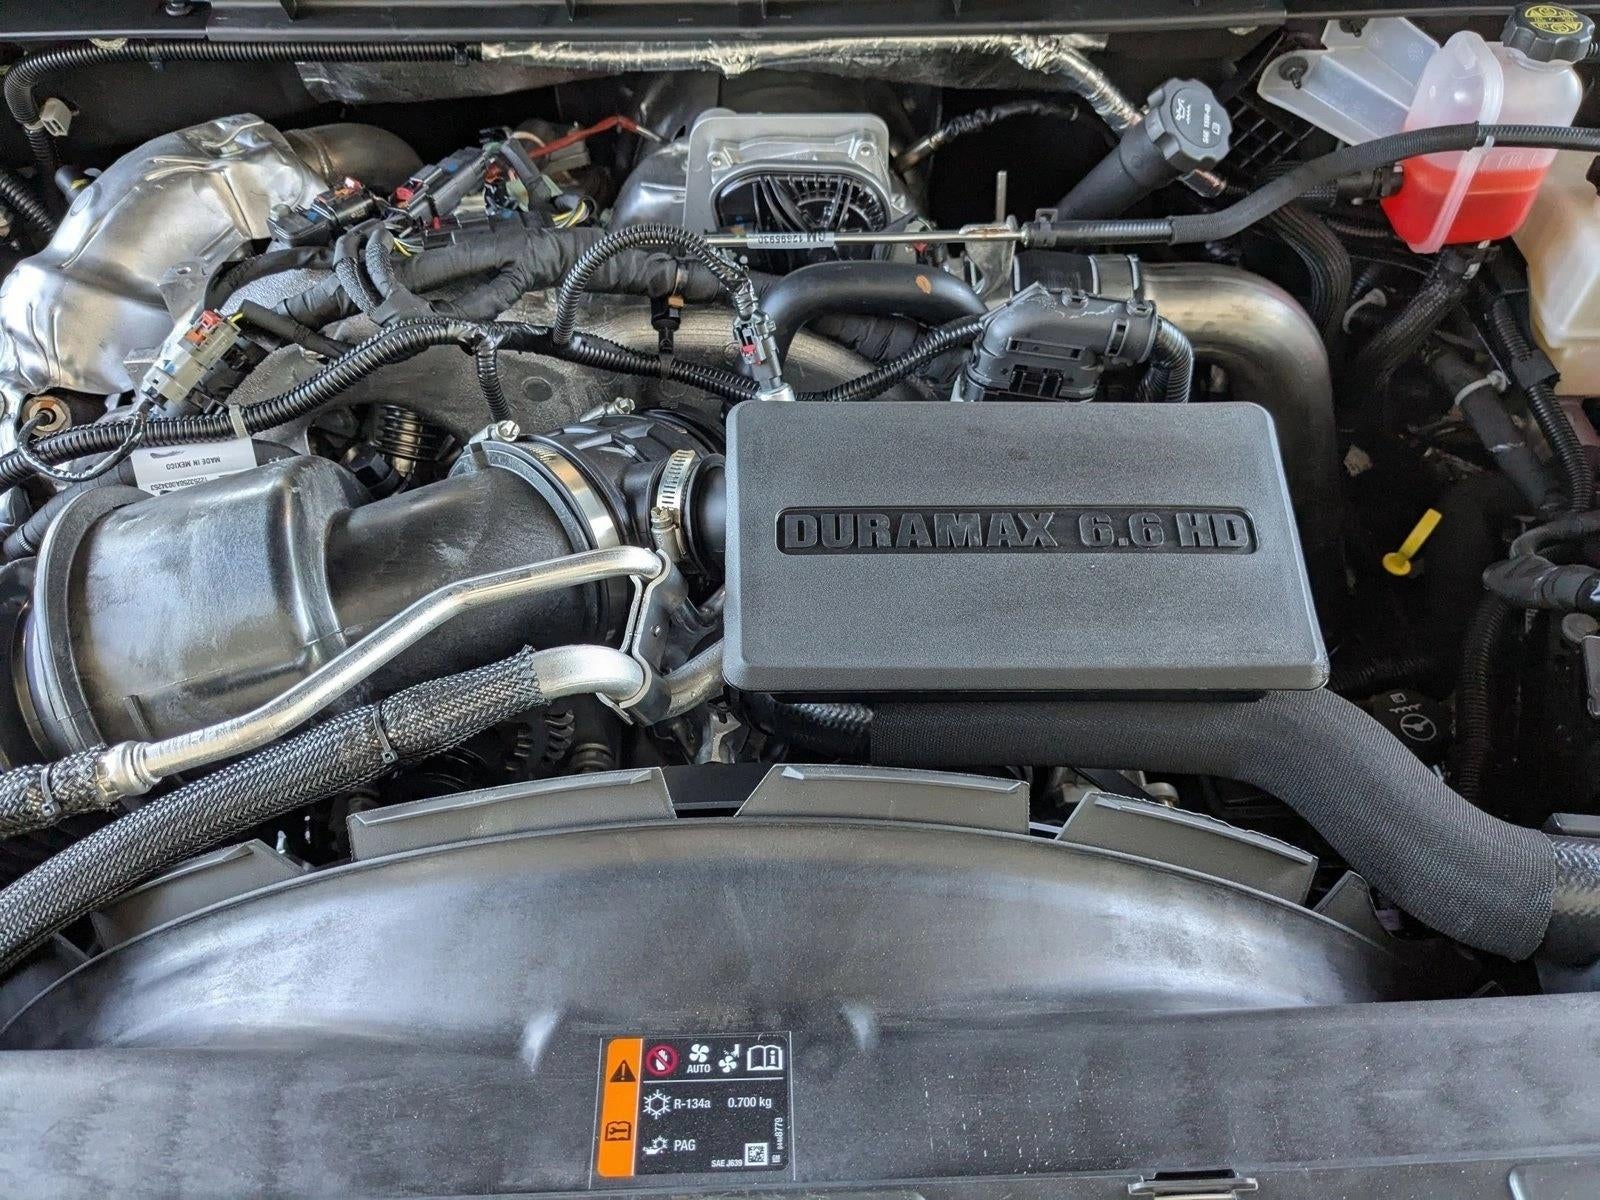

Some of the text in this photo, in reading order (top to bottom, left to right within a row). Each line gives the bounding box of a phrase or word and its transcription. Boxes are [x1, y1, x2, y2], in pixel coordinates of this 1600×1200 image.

[166, 461, 192, 470] MEXICO
[202, 456, 221, 466] MADE
[783, 511, 1251, 550] DURAMAX 6.6 HD
[686, 1063, 711, 1074] AUTO
[673, 1096, 772, 1109] R-134a 0.700 kg
[673, 1139, 696, 1151] PAG
[711, 1159, 743, 1168] SAE J639
